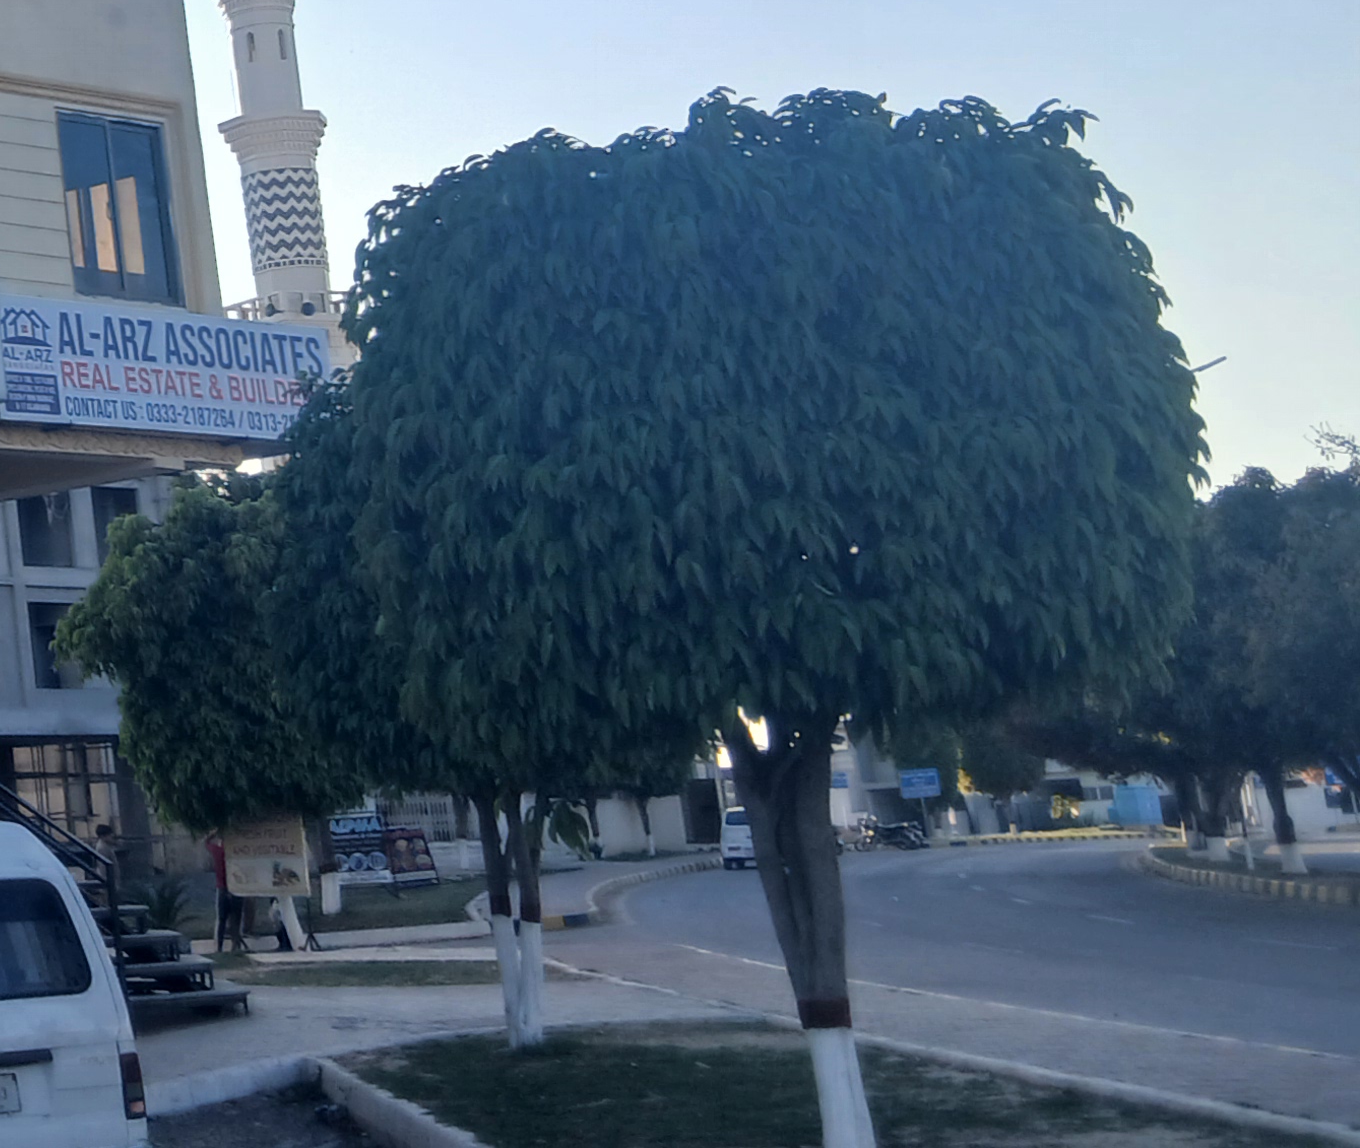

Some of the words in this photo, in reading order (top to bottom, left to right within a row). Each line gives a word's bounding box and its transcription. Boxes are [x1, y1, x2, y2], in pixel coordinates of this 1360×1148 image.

[3, 346, 54, 364] AL-ARZ
[58, 311, 157, 363] AL-ARZ
[165, 322, 323, 379] ASSOCIATES
[60, 360, 120, 392] REAL
[124, 367, 205, 400] ESTATE
[209, 373, 224, 401] &
[228, 374, 310, 408] BUILDE
[64, 395, 120, 420] CONTACT
